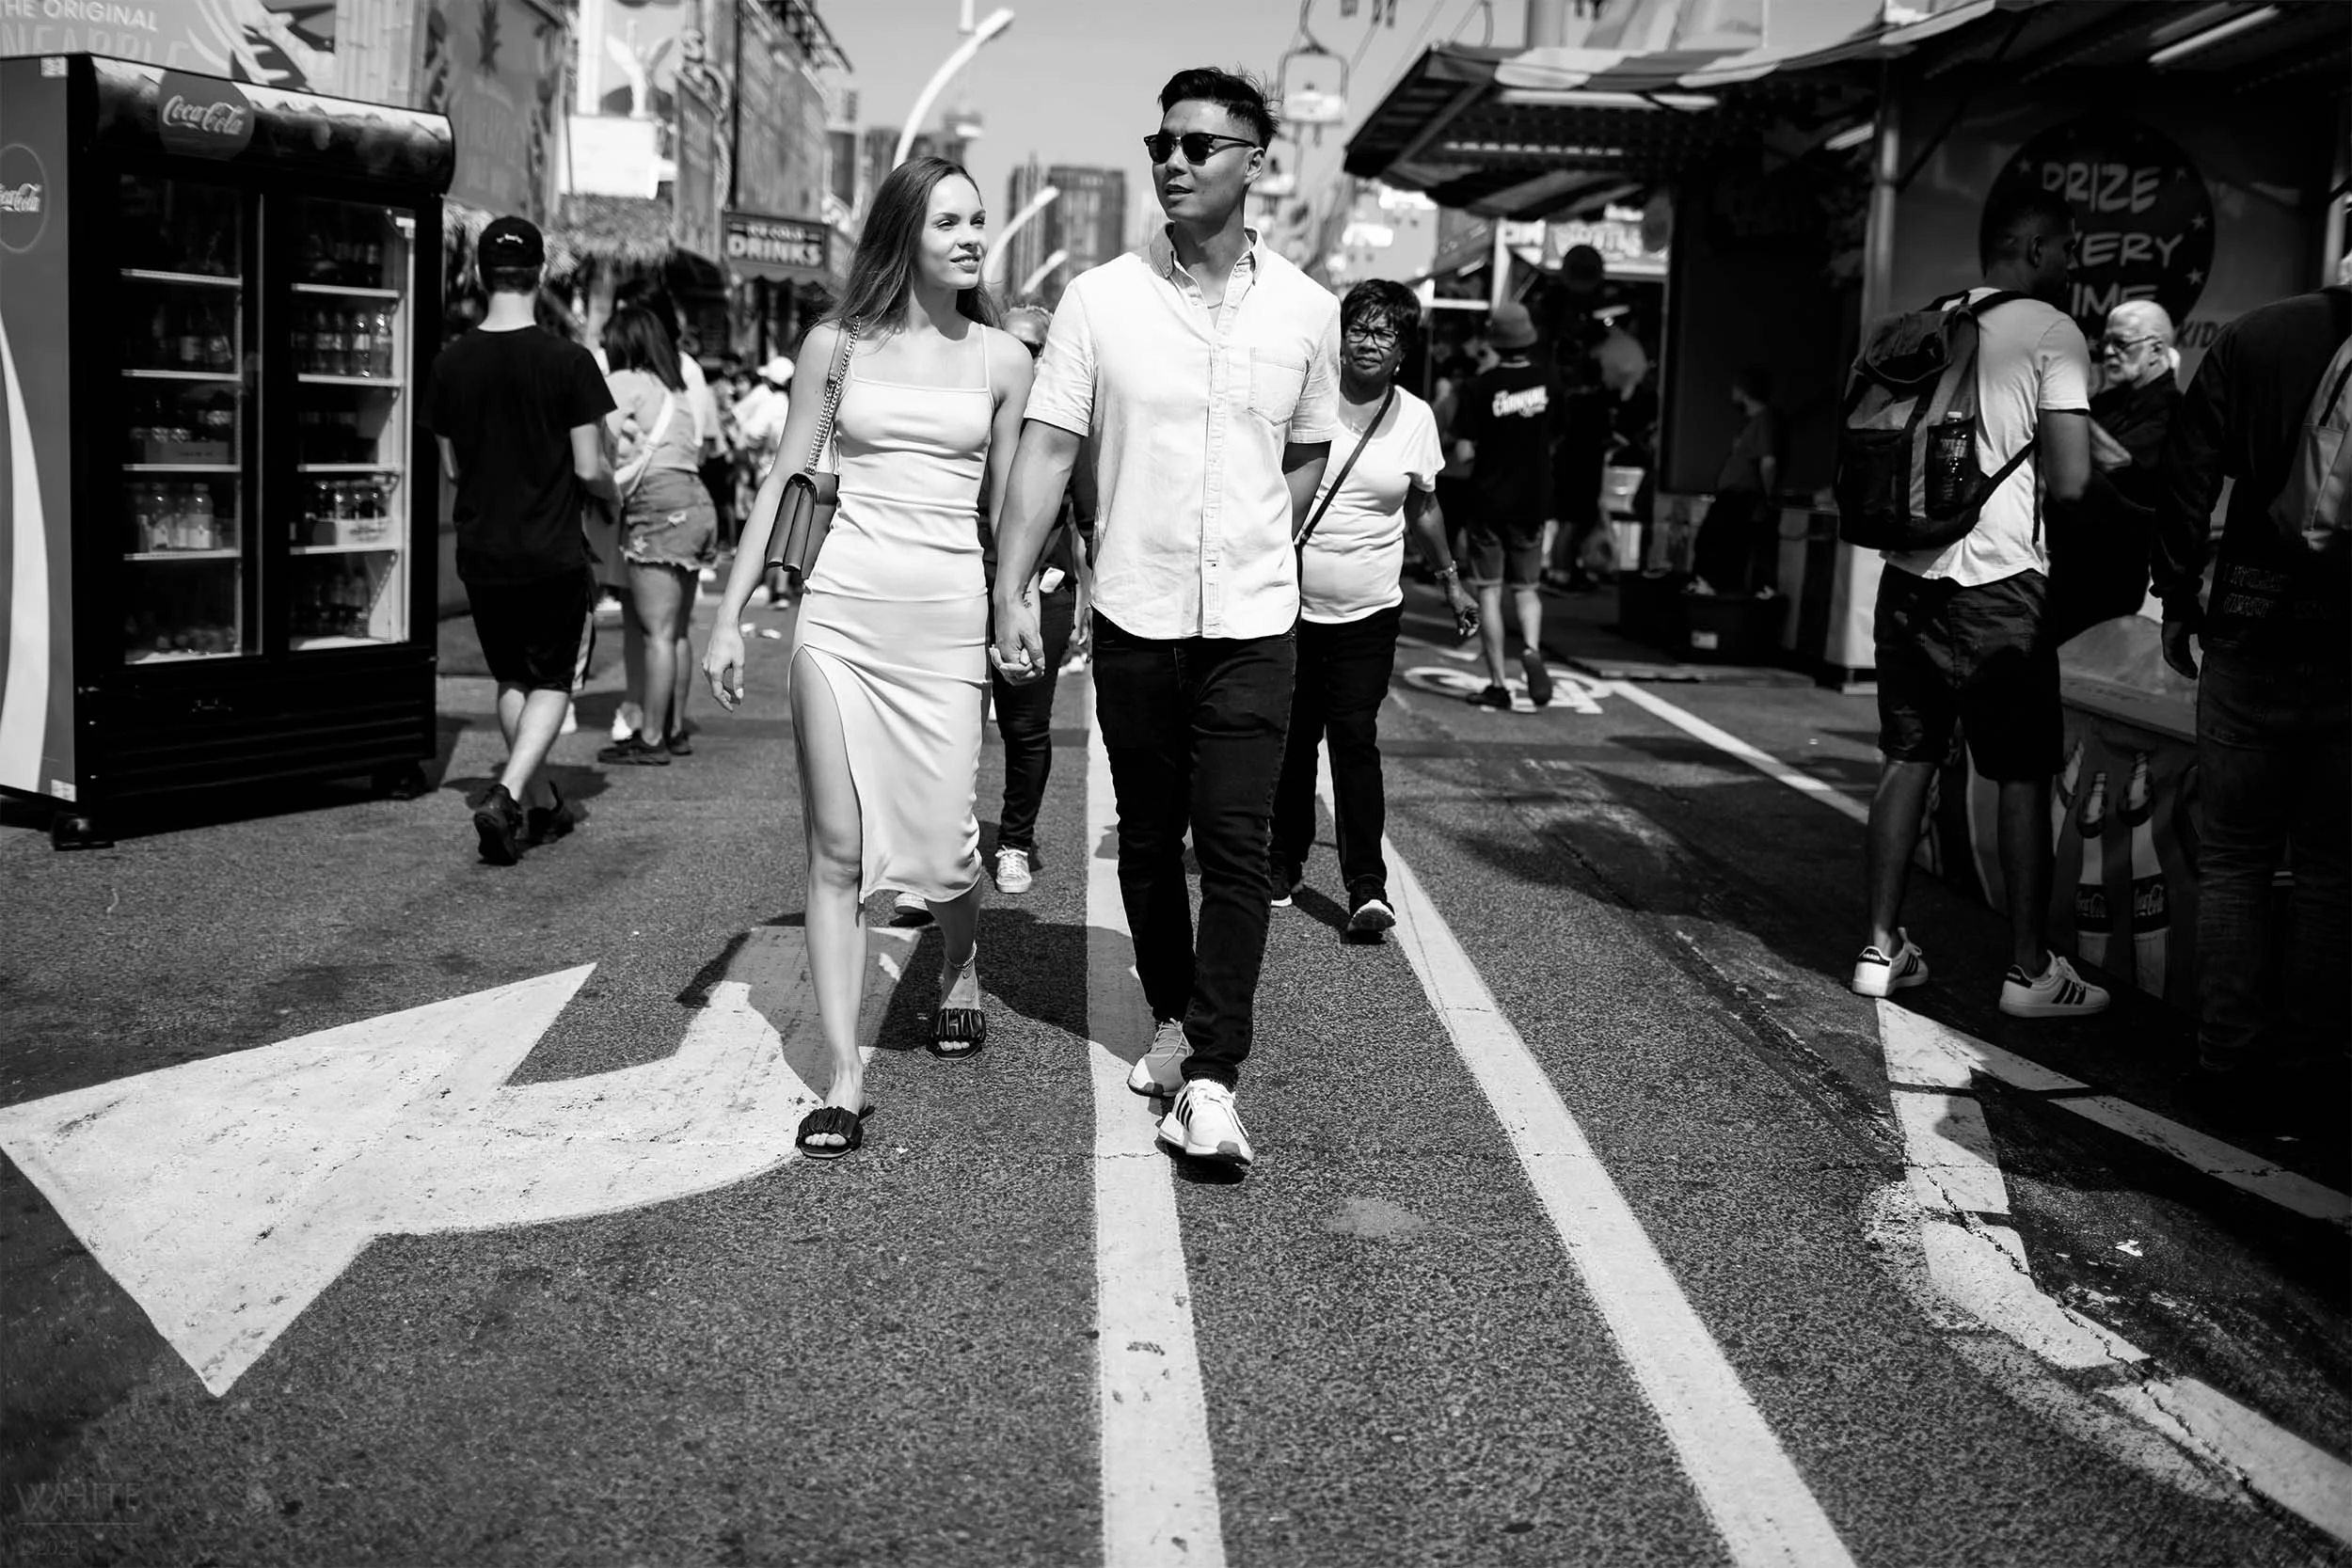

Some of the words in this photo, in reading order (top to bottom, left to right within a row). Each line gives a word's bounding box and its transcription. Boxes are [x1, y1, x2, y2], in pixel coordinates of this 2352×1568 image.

[0, 0, 37, 18] HE
[43, 0, 160, 32] ORIGINAL
[162, 95, 247, 135] Coca-Cola
[2042, 161, 2162, 214] PRIZE
[727, 234, 822, 266] DRINKS
[2069, 280, 2160, 319] IME
